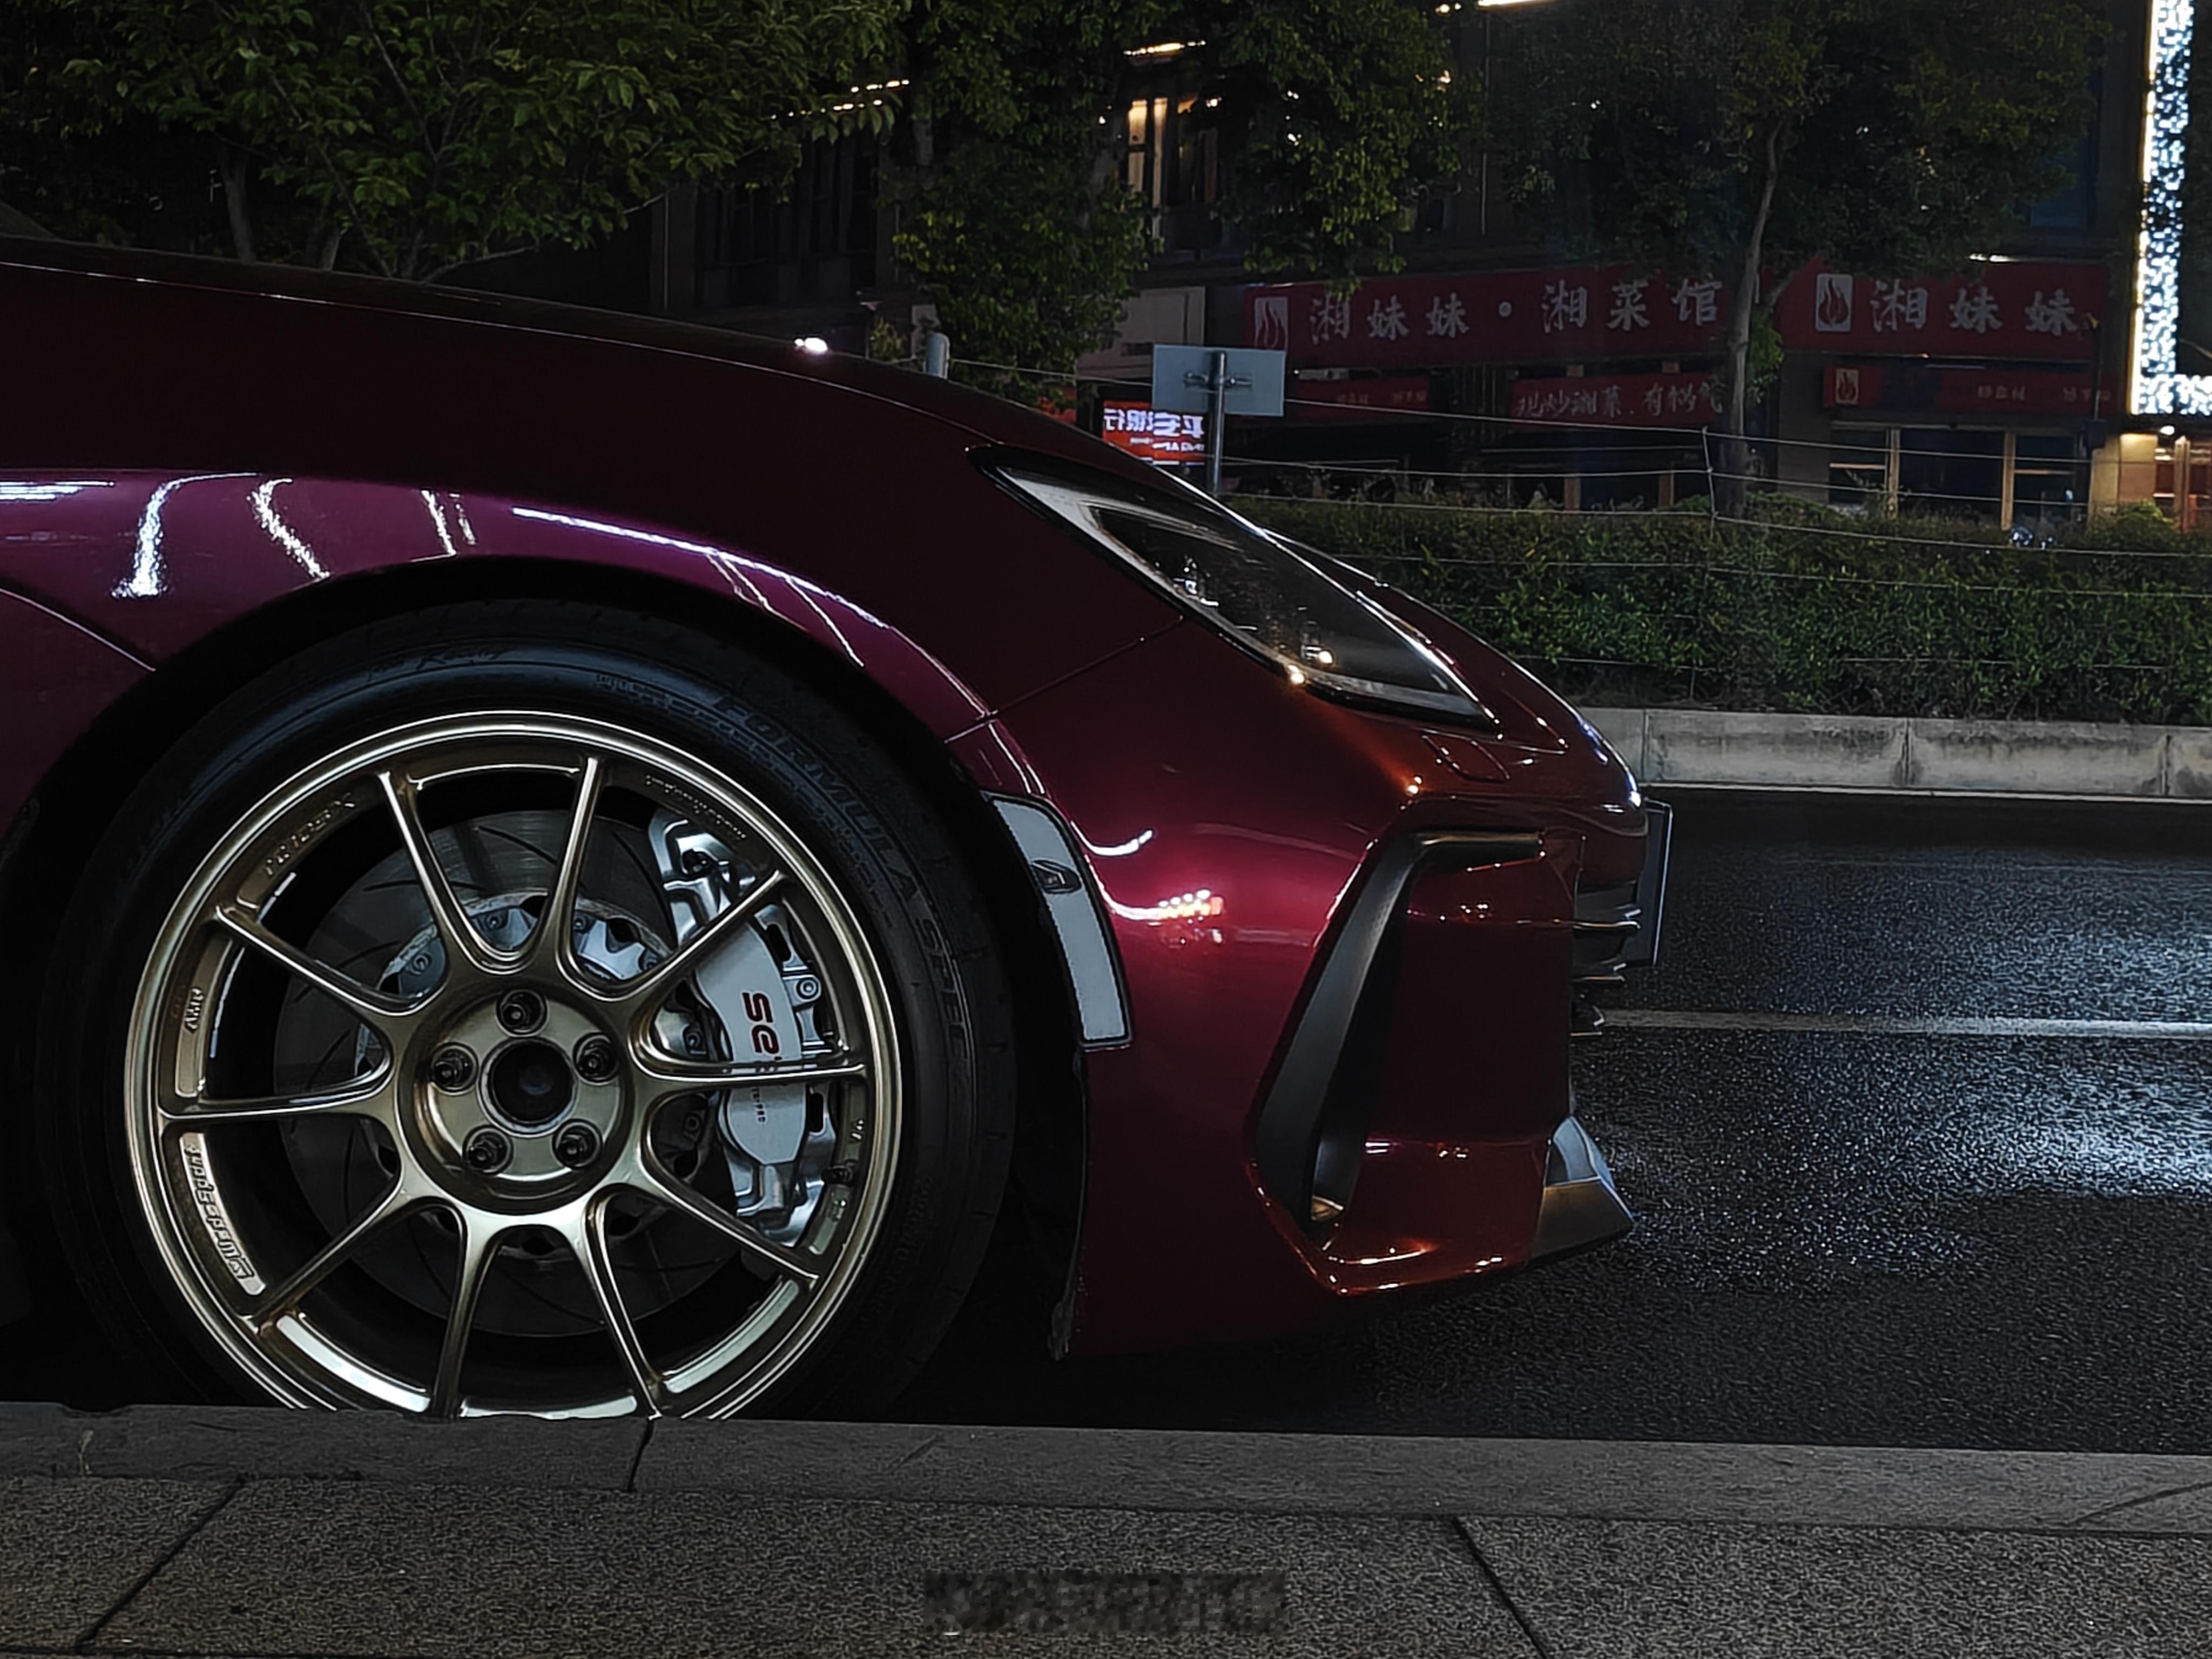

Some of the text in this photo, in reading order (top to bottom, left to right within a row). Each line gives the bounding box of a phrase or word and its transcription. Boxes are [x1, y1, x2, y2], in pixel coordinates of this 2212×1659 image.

[1870, 279, 2079, 336] 湘妹妹
[712, 692, 914, 903] FORMULA
[919, 918, 969, 1060] SPEC
